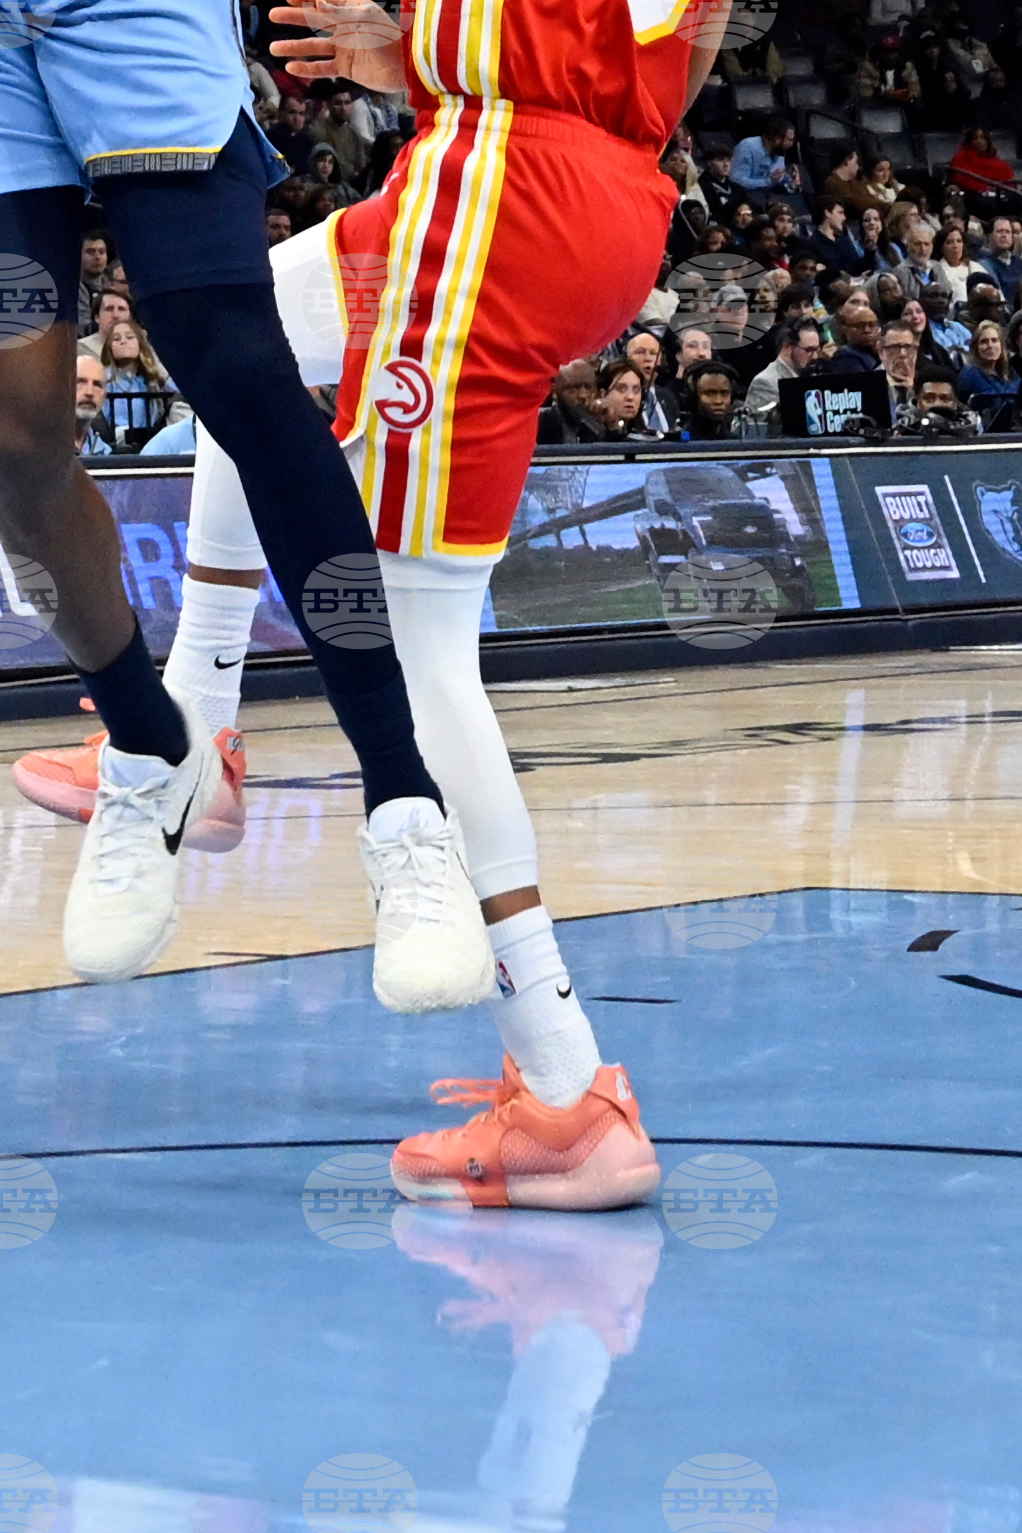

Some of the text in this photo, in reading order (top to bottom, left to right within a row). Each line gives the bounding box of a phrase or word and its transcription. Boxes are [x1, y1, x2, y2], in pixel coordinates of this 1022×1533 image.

[824, 388, 862, 413] Replay
[885, 495, 930, 520] BUILT
[904, 538, 950, 569] TOUGH
